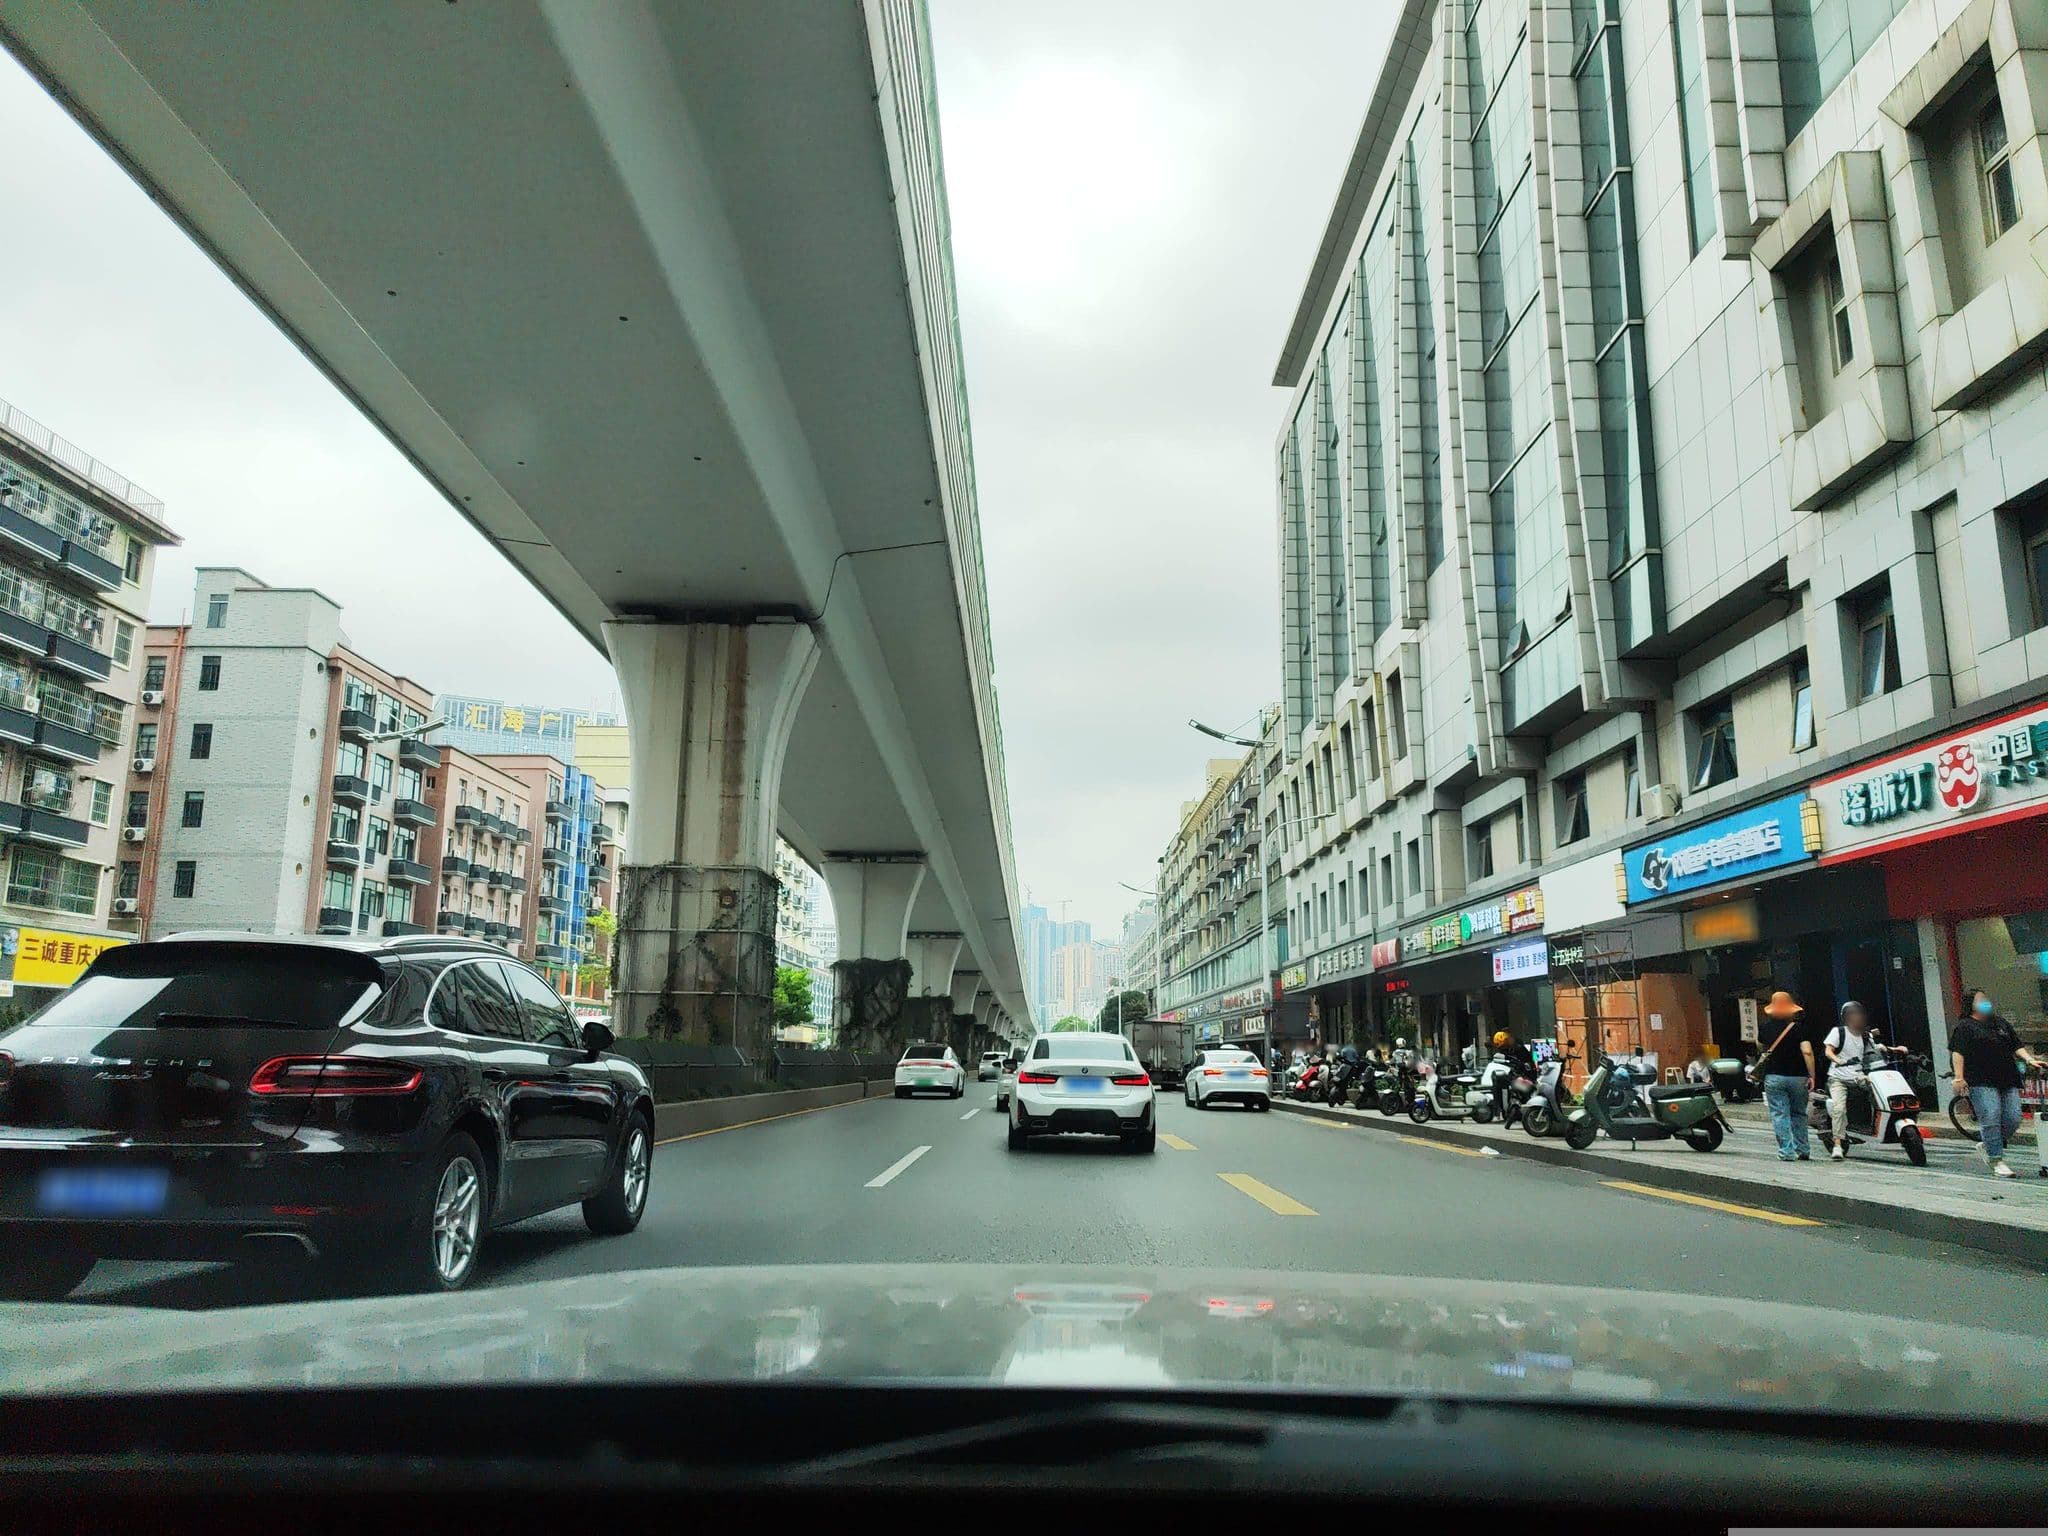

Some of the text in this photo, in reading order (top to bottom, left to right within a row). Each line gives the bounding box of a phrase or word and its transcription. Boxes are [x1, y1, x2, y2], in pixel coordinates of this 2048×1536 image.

[1993, 755, 2048, 785] TAS
[1840, 763, 1930, 826] 塔斯汀
[40, 1056, 213, 1067] PORSCHE
